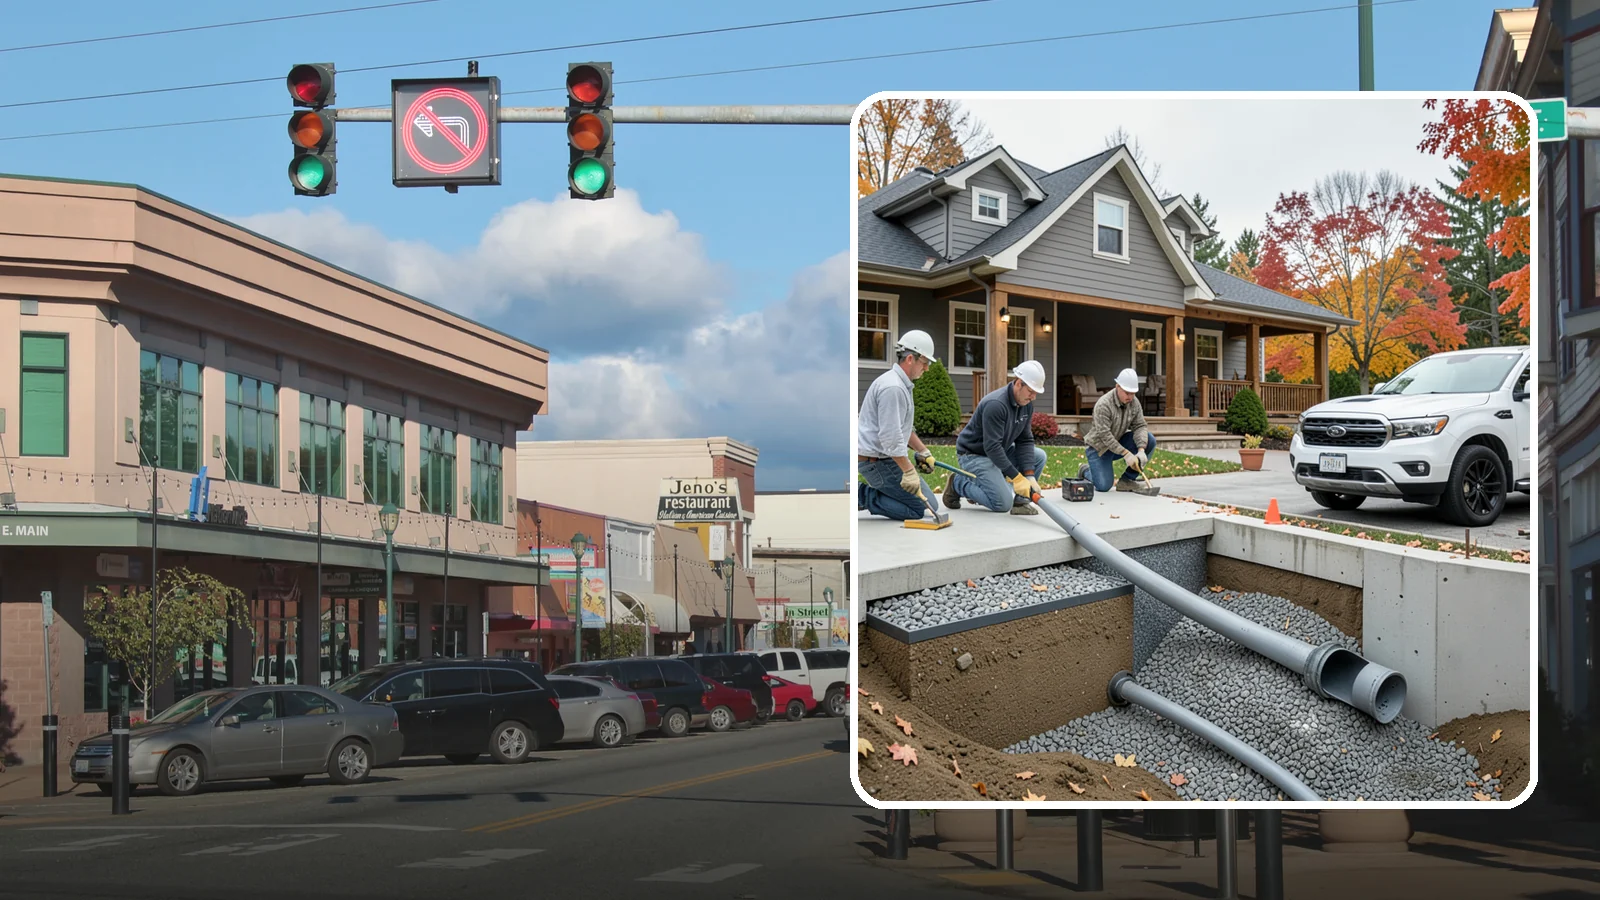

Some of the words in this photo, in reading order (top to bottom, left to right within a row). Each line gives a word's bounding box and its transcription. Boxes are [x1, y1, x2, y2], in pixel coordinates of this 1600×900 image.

[669, 479, 728, 495] Jeno's
[665, 496, 731, 509] restaurant
[658, 510, 681, 519] Italian
[686, 510, 714, 519] American
[715, 509, 737, 519] Cuisine
[2, 525, 13, 536] E.
[15, 525, 49, 536] MAIN
[797, 607, 828, 617] Street
